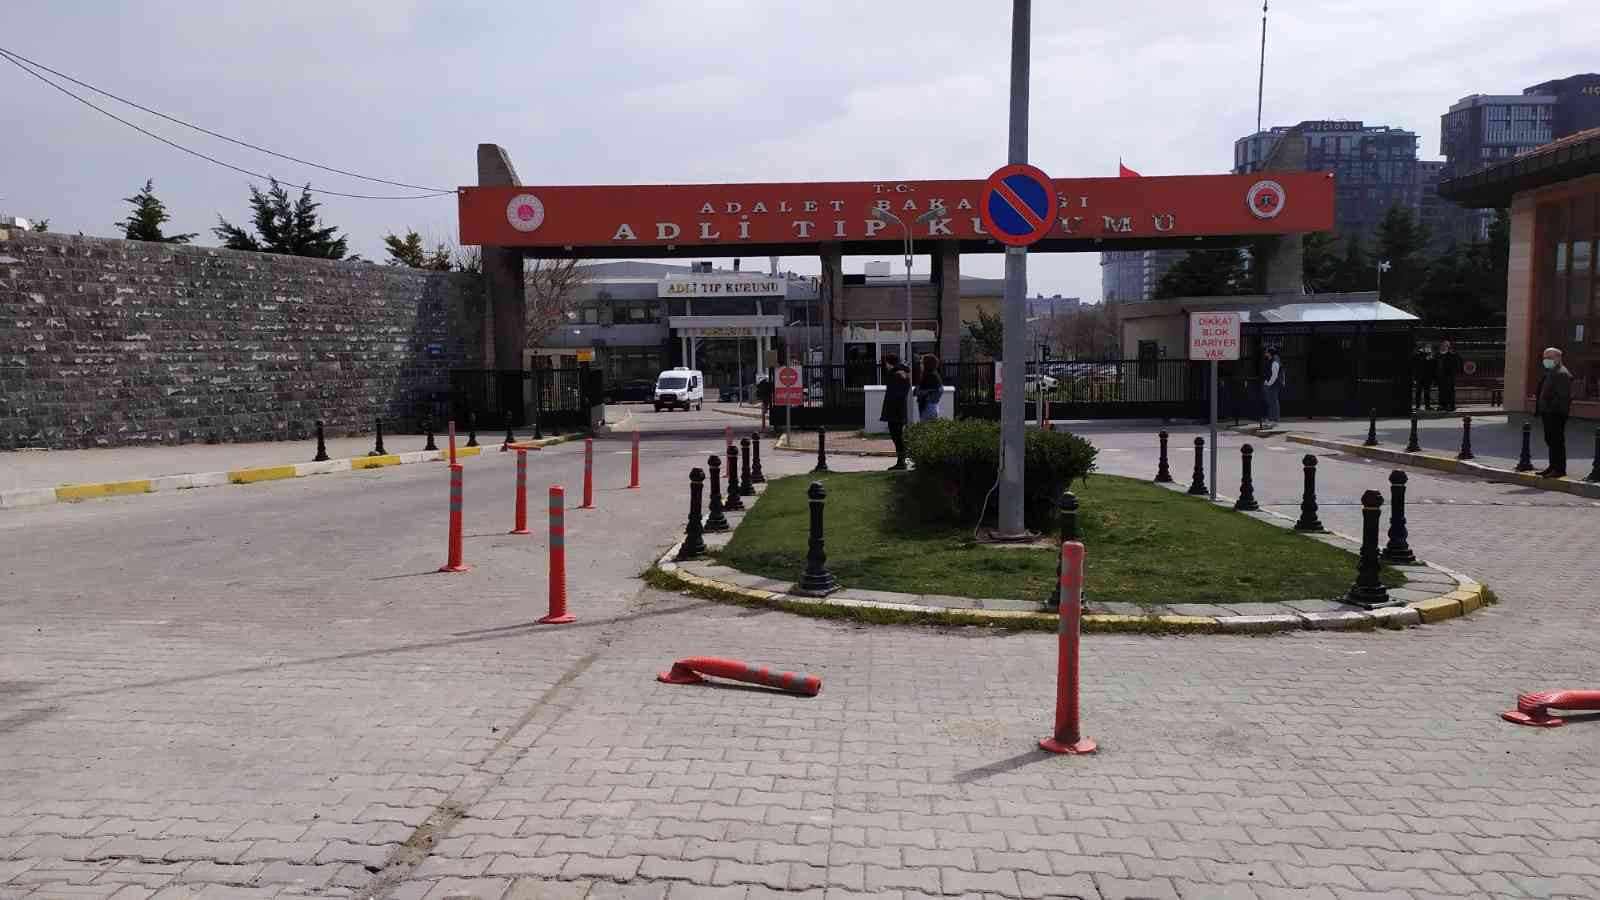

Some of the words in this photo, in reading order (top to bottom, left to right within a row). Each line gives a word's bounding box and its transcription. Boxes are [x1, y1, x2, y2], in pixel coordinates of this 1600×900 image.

[700, 200, 845, 214] ADALET
[876, 192, 1090, 211] BAKAĞI
[612, 214, 751, 240] ADLİ
[792, 218, 888, 238] TIP
[927, 213, 1176, 236] KUUMU
[702, 282, 721, 293] TIP
[726, 281, 779, 293] KURUMU
[1202, 328, 1229, 337] BLOK
